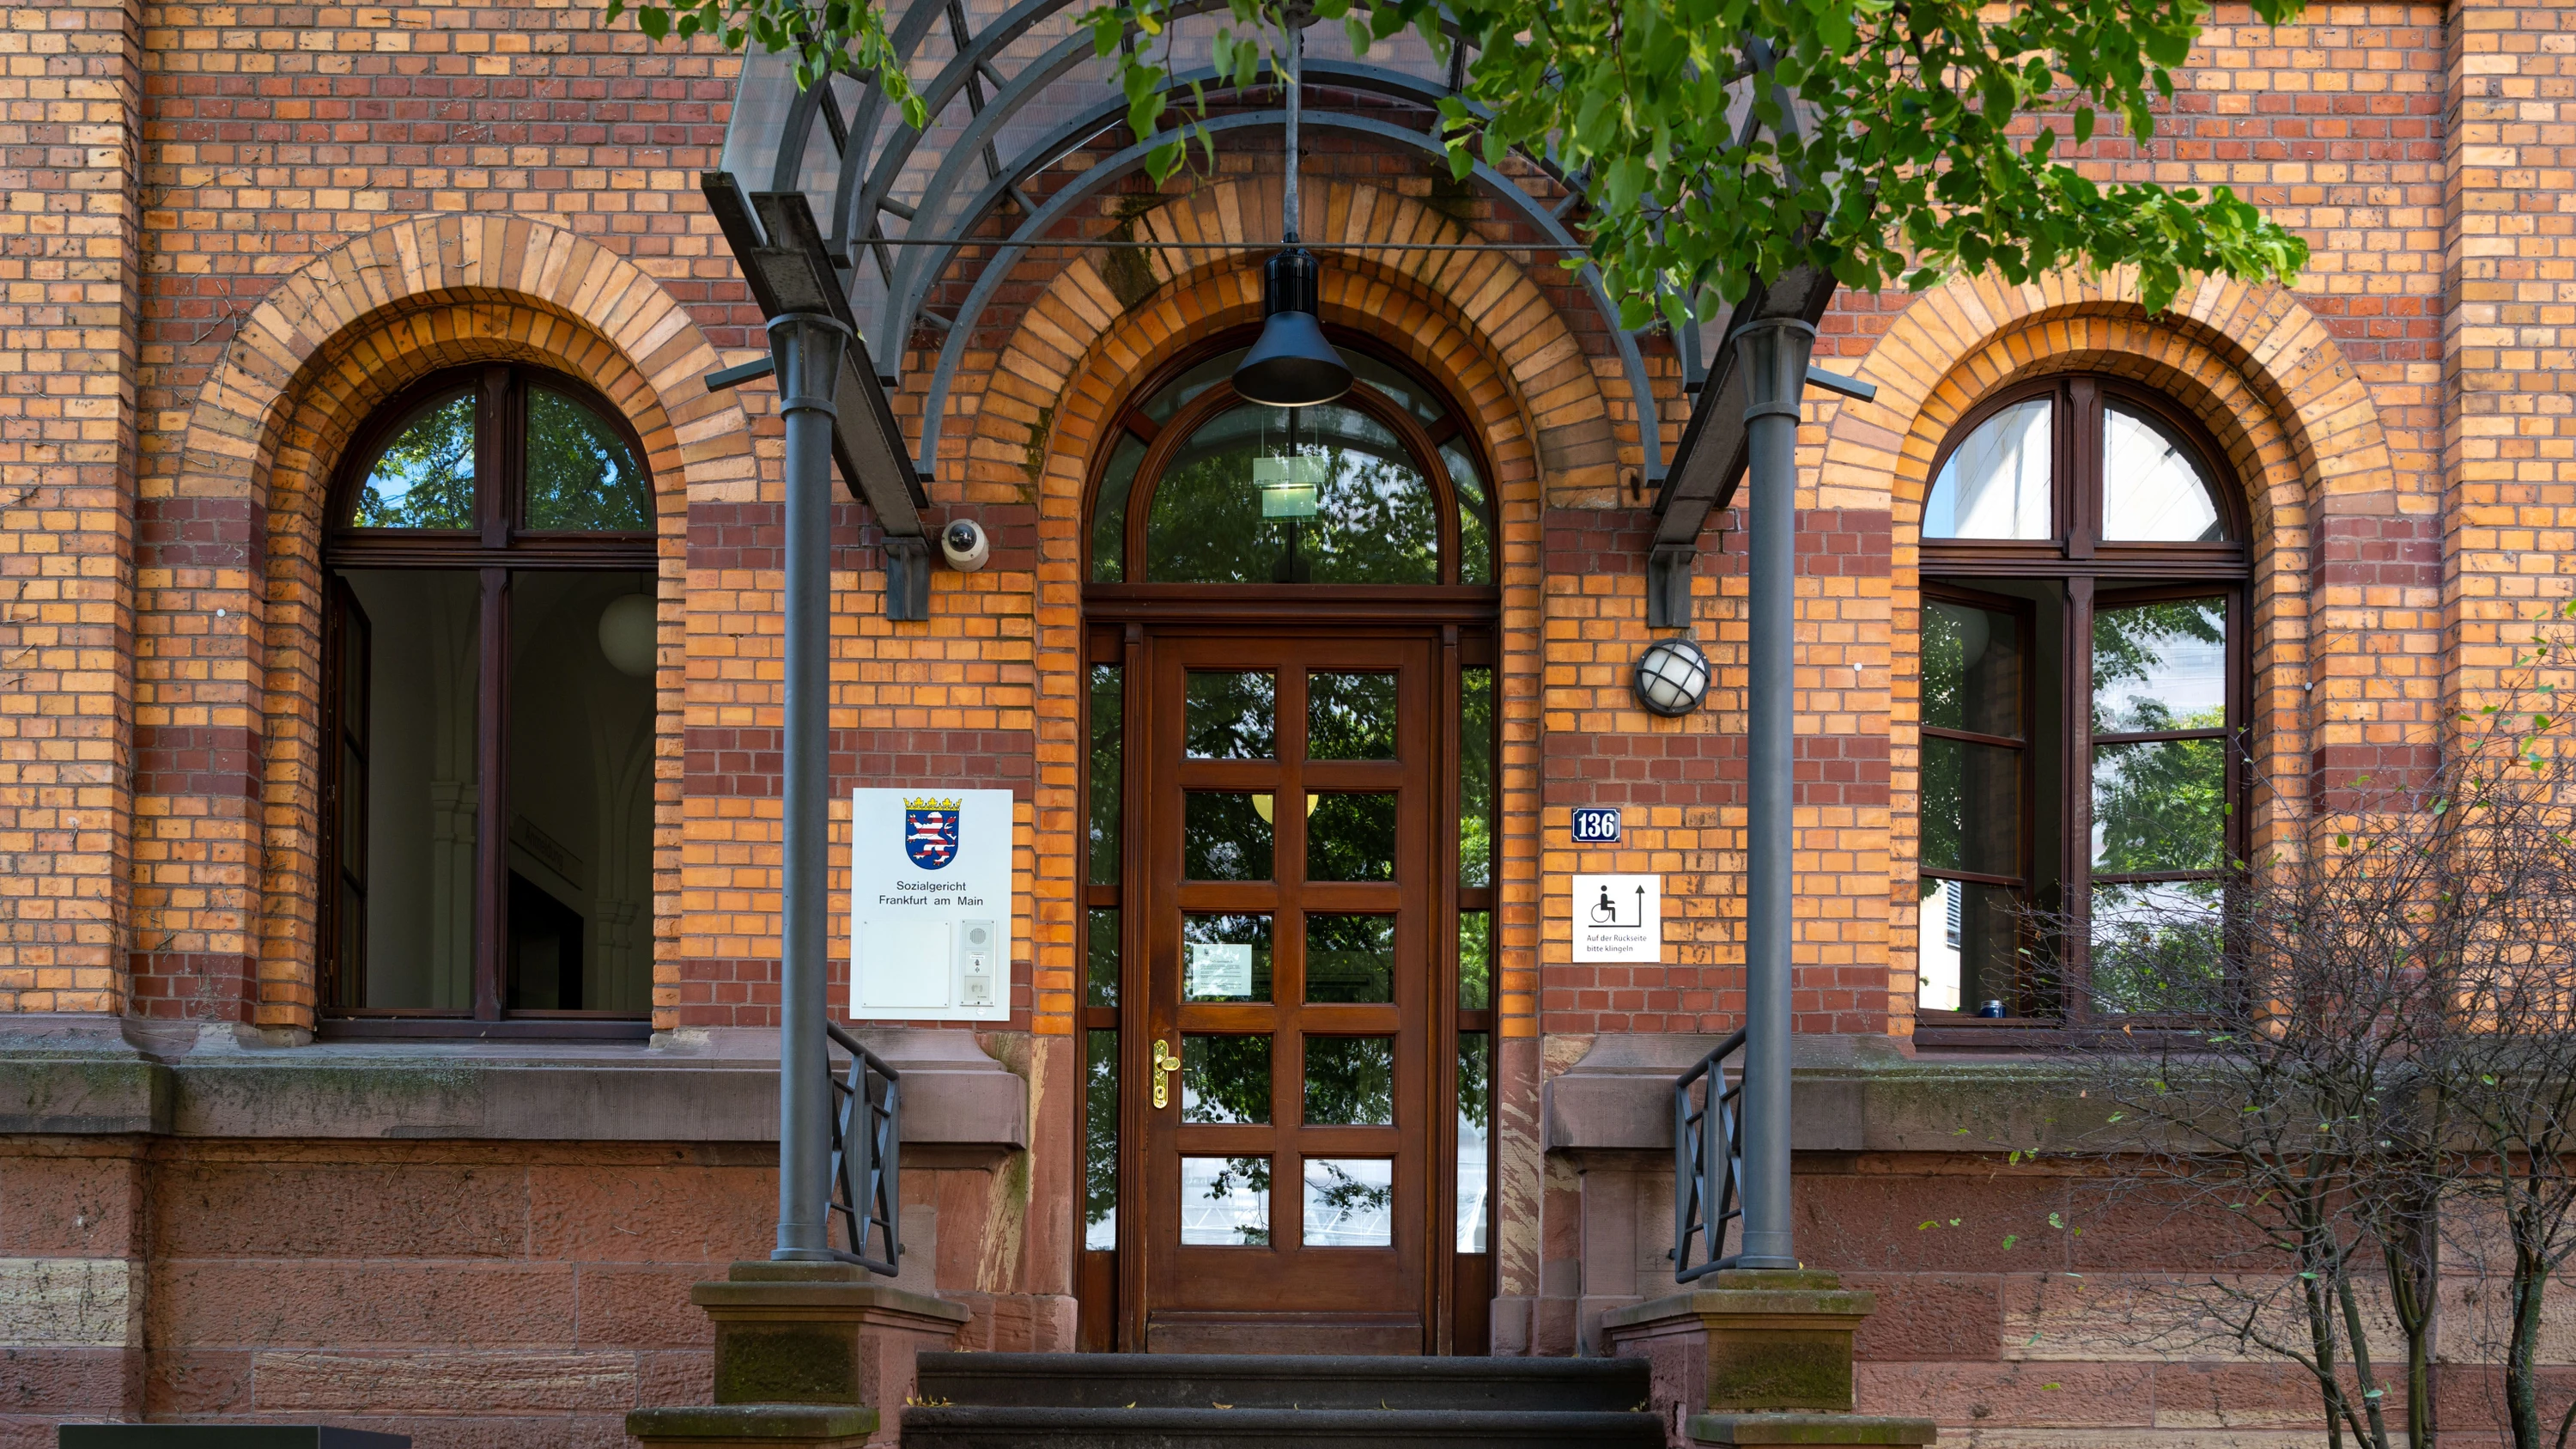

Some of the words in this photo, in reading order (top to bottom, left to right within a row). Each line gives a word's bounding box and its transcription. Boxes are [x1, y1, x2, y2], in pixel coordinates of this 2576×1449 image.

[1578, 813, 1615, 837] 136
[525, 825, 563, 871] Anmeldung
[896, 880, 967, 892] Sozialgericht
[879, 895, 927, 905] Frankfurt
[957, 896, 983, 906] Main
[1605, 945, 1633, 953] klingeln
